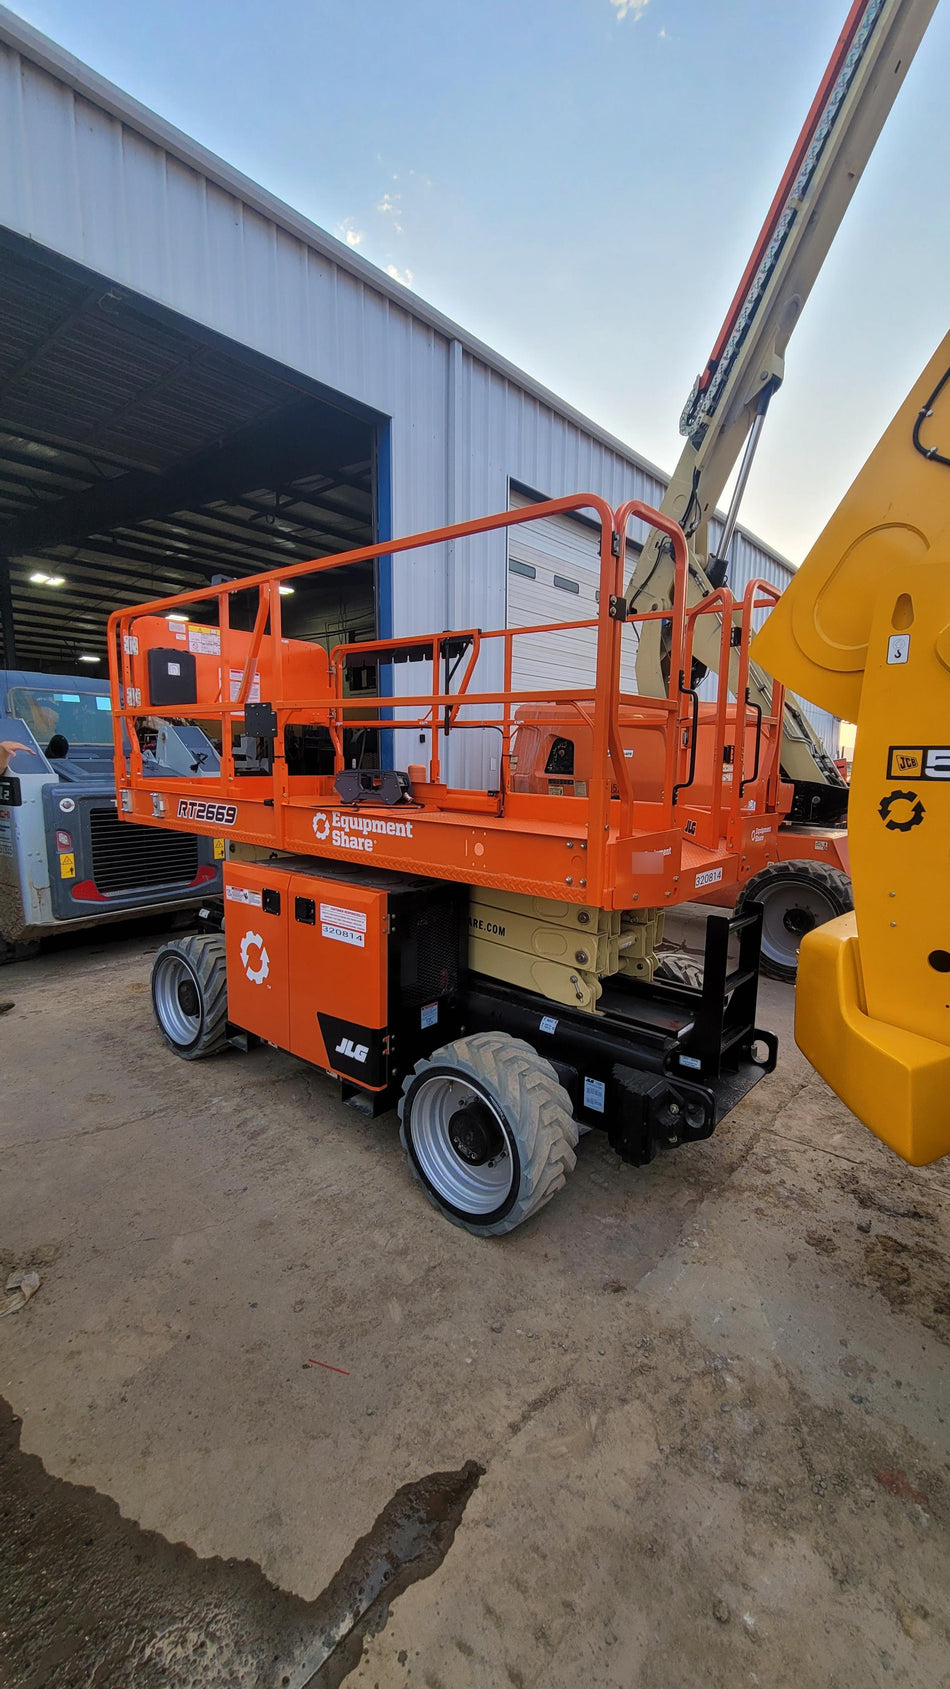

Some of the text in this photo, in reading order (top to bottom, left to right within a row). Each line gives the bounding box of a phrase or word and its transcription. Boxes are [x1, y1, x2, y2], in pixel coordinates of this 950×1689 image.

[900, 757, 917, 769] JCB
[177, 799, 238, 825] RT2669
[332, 811, 413, 838] Equipment
[685, 820, 697, 836] JLG
[332, 830, 373, 852] Share
[695, 870, 722, 887] 320814
[322, 925, 363, 942] 320814
[335, 1037, 370, 1063] JLG
